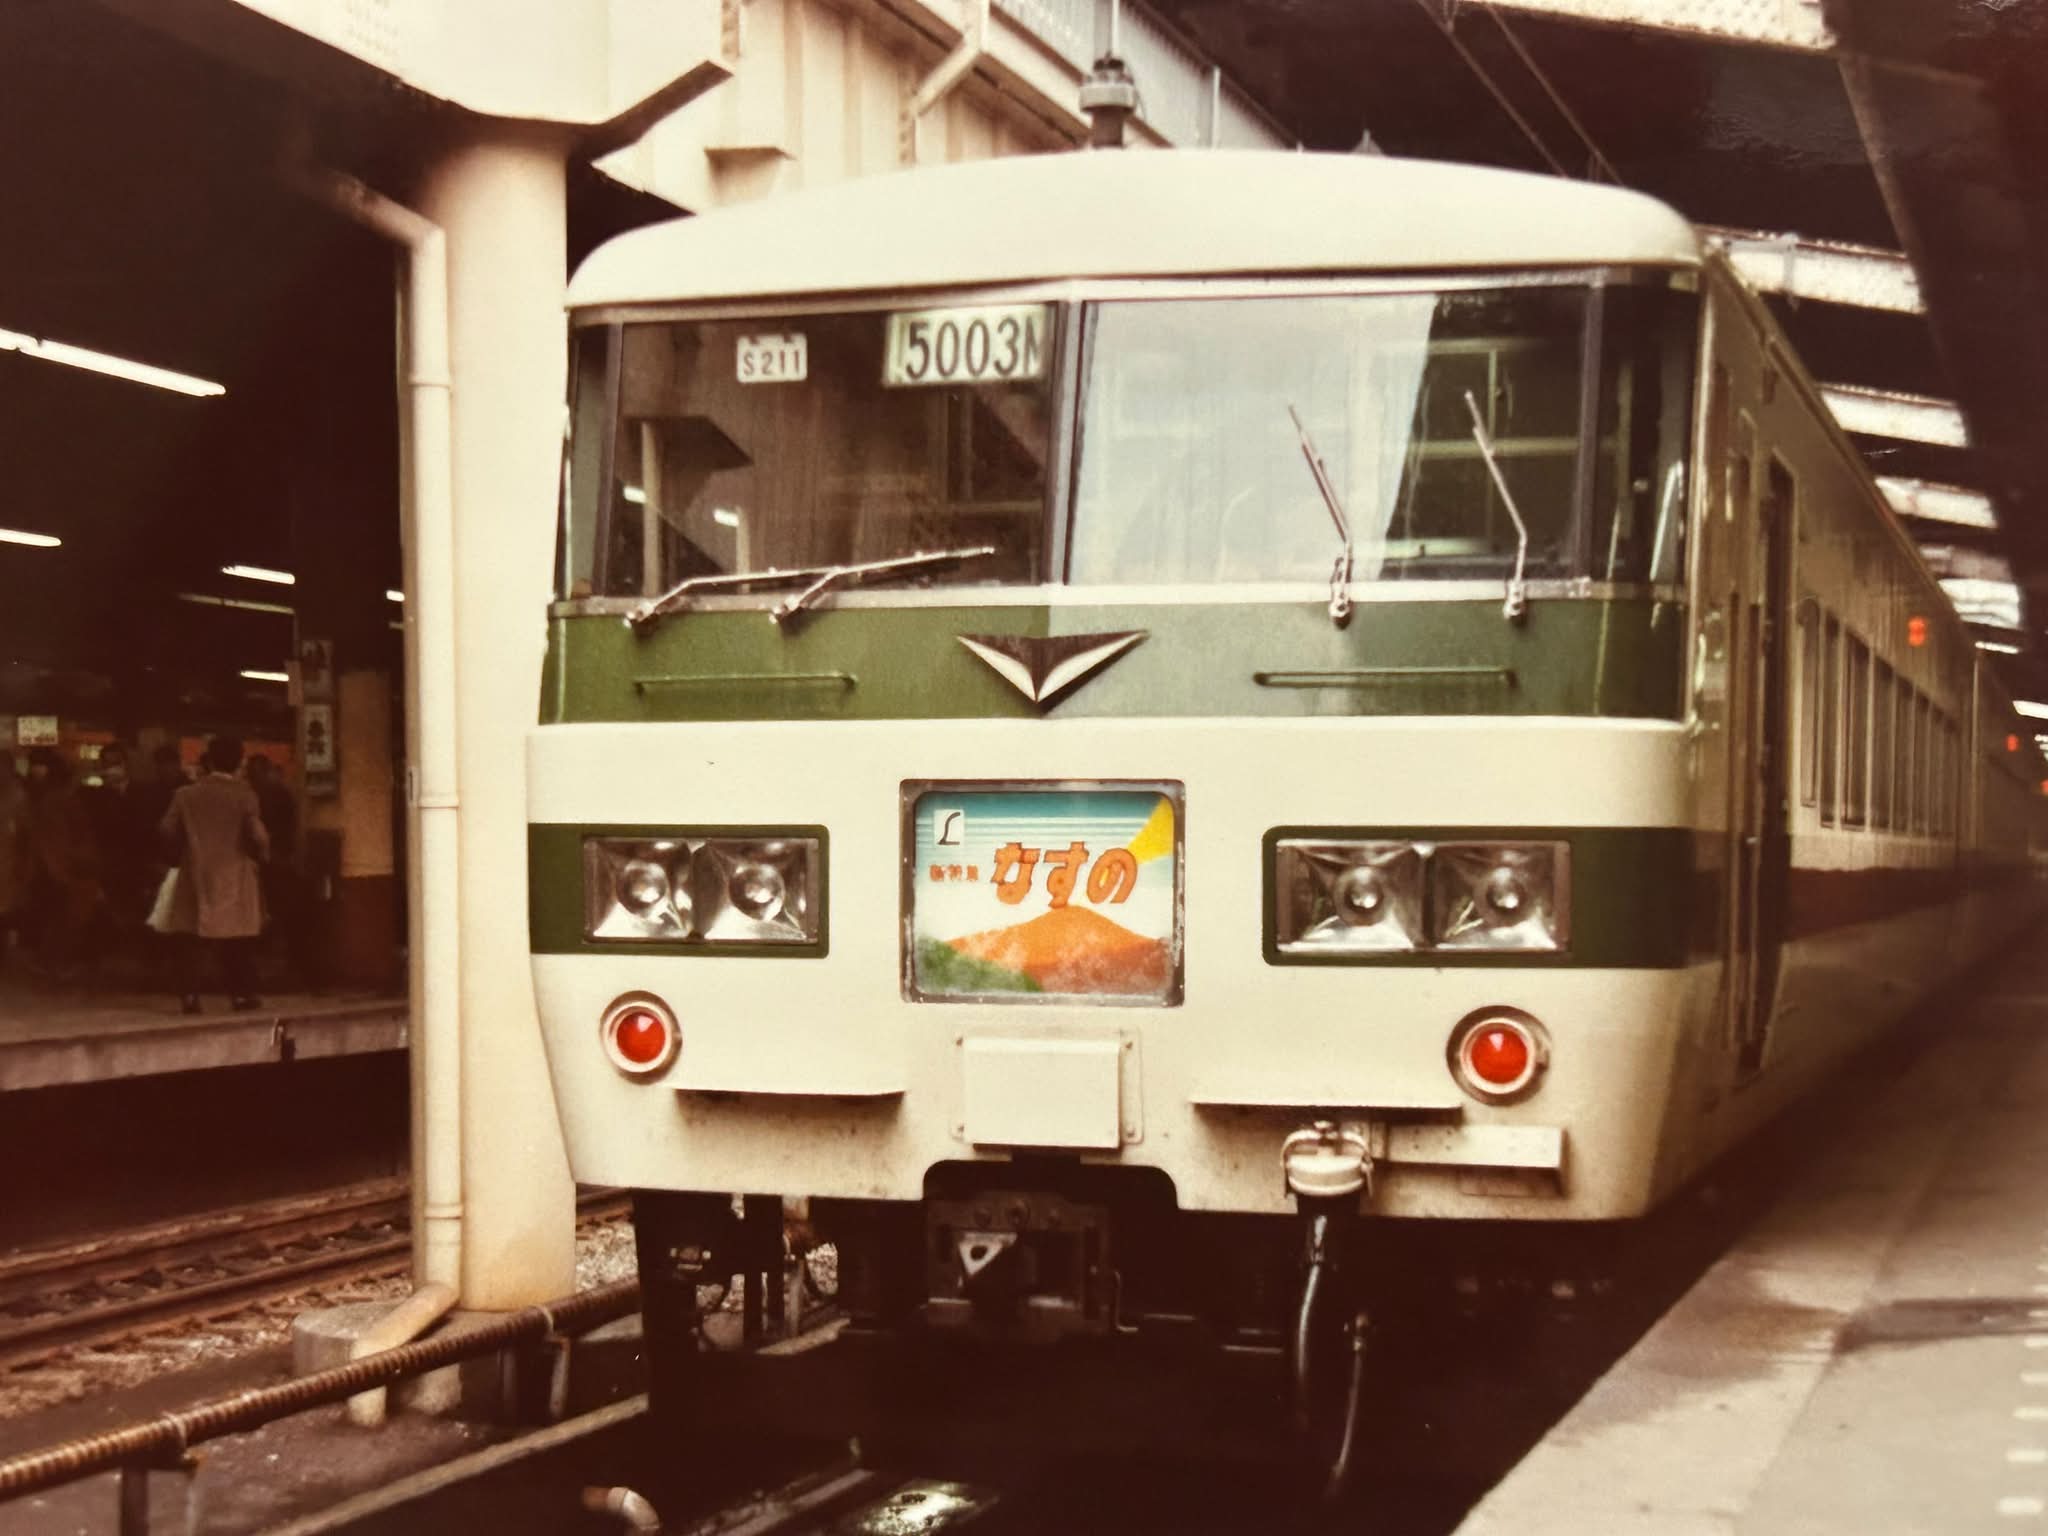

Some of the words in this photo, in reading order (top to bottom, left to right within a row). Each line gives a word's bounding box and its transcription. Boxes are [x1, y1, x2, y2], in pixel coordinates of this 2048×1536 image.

[743, 350, 800, 376] S211
[990, 841, 1138, 909] なすの
